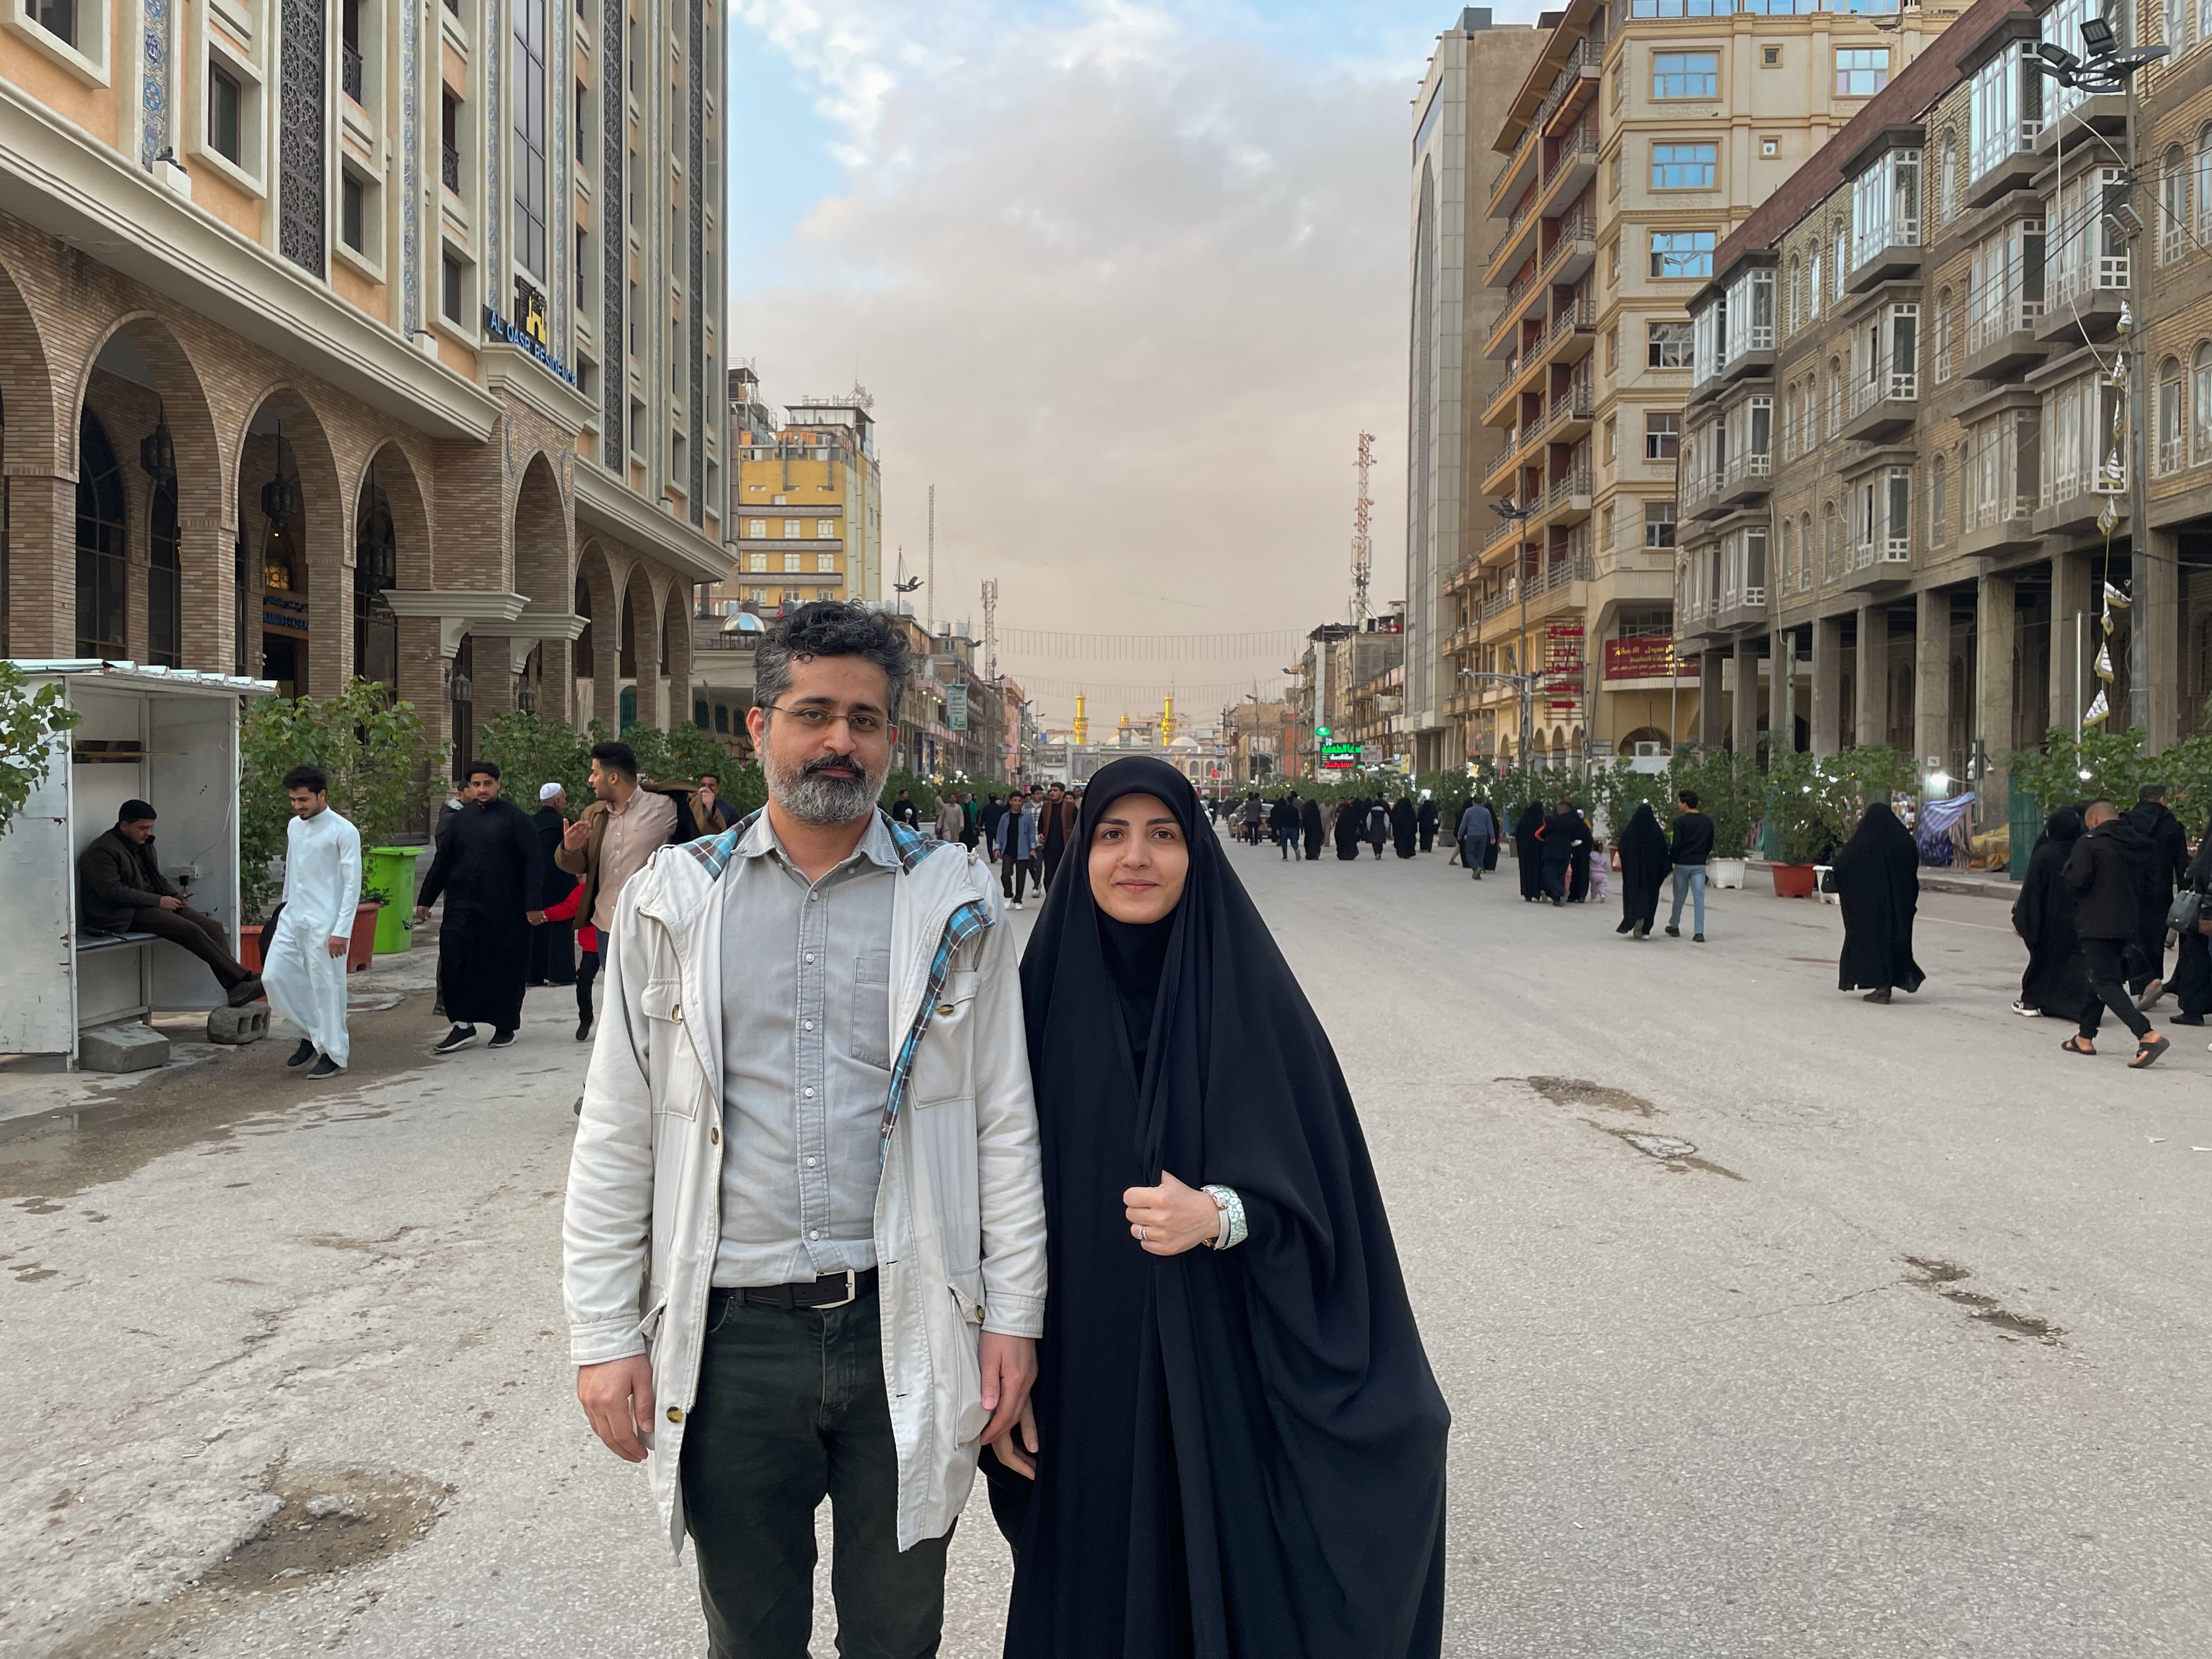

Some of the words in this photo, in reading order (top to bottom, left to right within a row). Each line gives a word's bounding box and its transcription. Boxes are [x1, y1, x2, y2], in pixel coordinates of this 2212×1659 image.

[491, 312, 503, 335] AL
[507, 324, 531, 352] QASR
[534, 343, 576, 386] RESIDENCE
